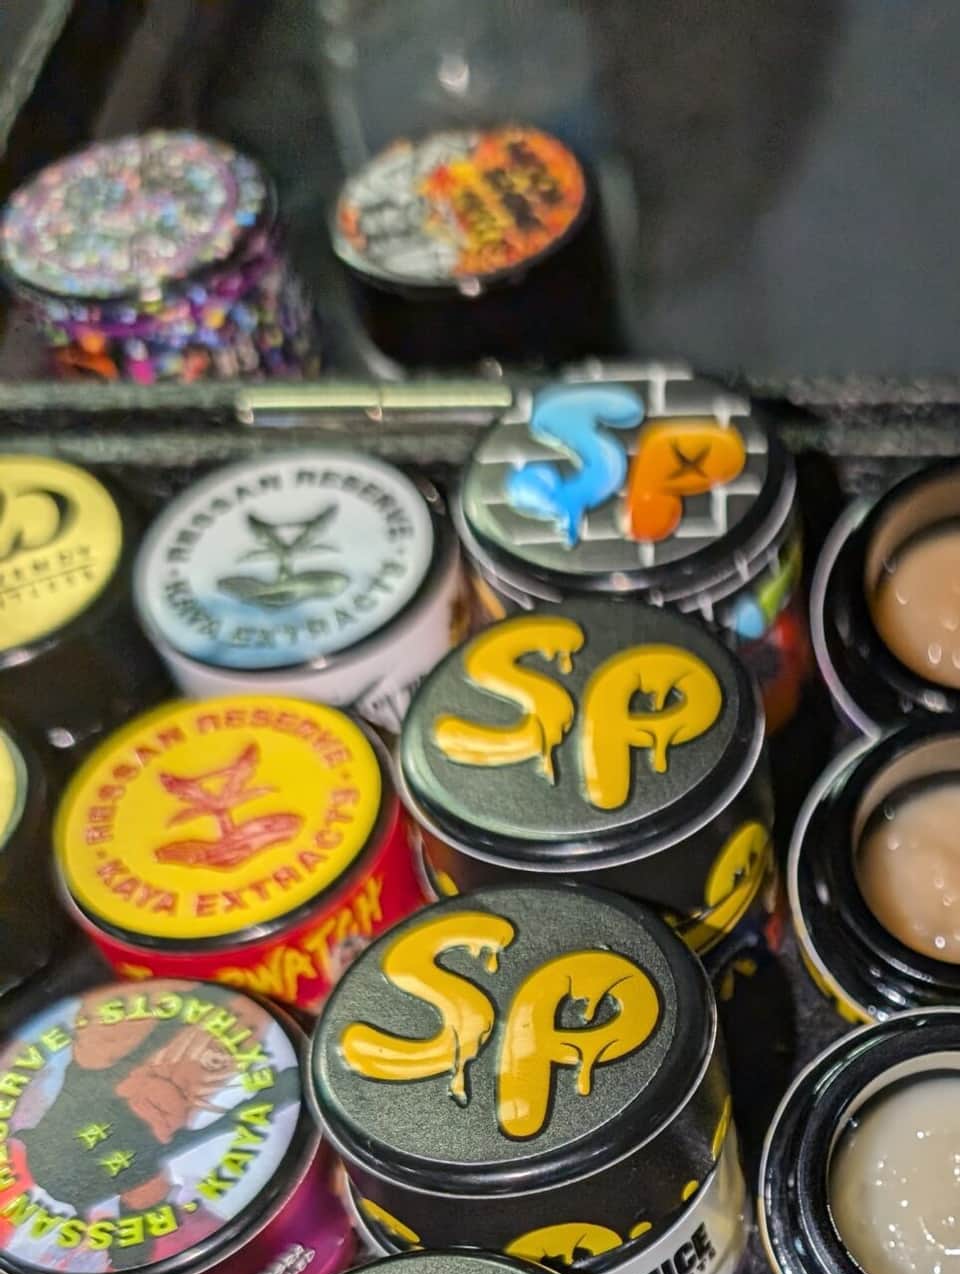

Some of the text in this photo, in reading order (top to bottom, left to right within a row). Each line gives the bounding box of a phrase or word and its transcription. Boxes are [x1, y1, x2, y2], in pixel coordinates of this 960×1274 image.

[196, 708, 353, 770] RESERVE
[433, 615, 722, 810] SP
[96, 787, 361, 917] KAYA EXTRACTS
[99, 991, 276, 1093] EXTRACTS
[340, 910, 661, 1140] SP
[195, 1102, 274, 1200] KAYA
